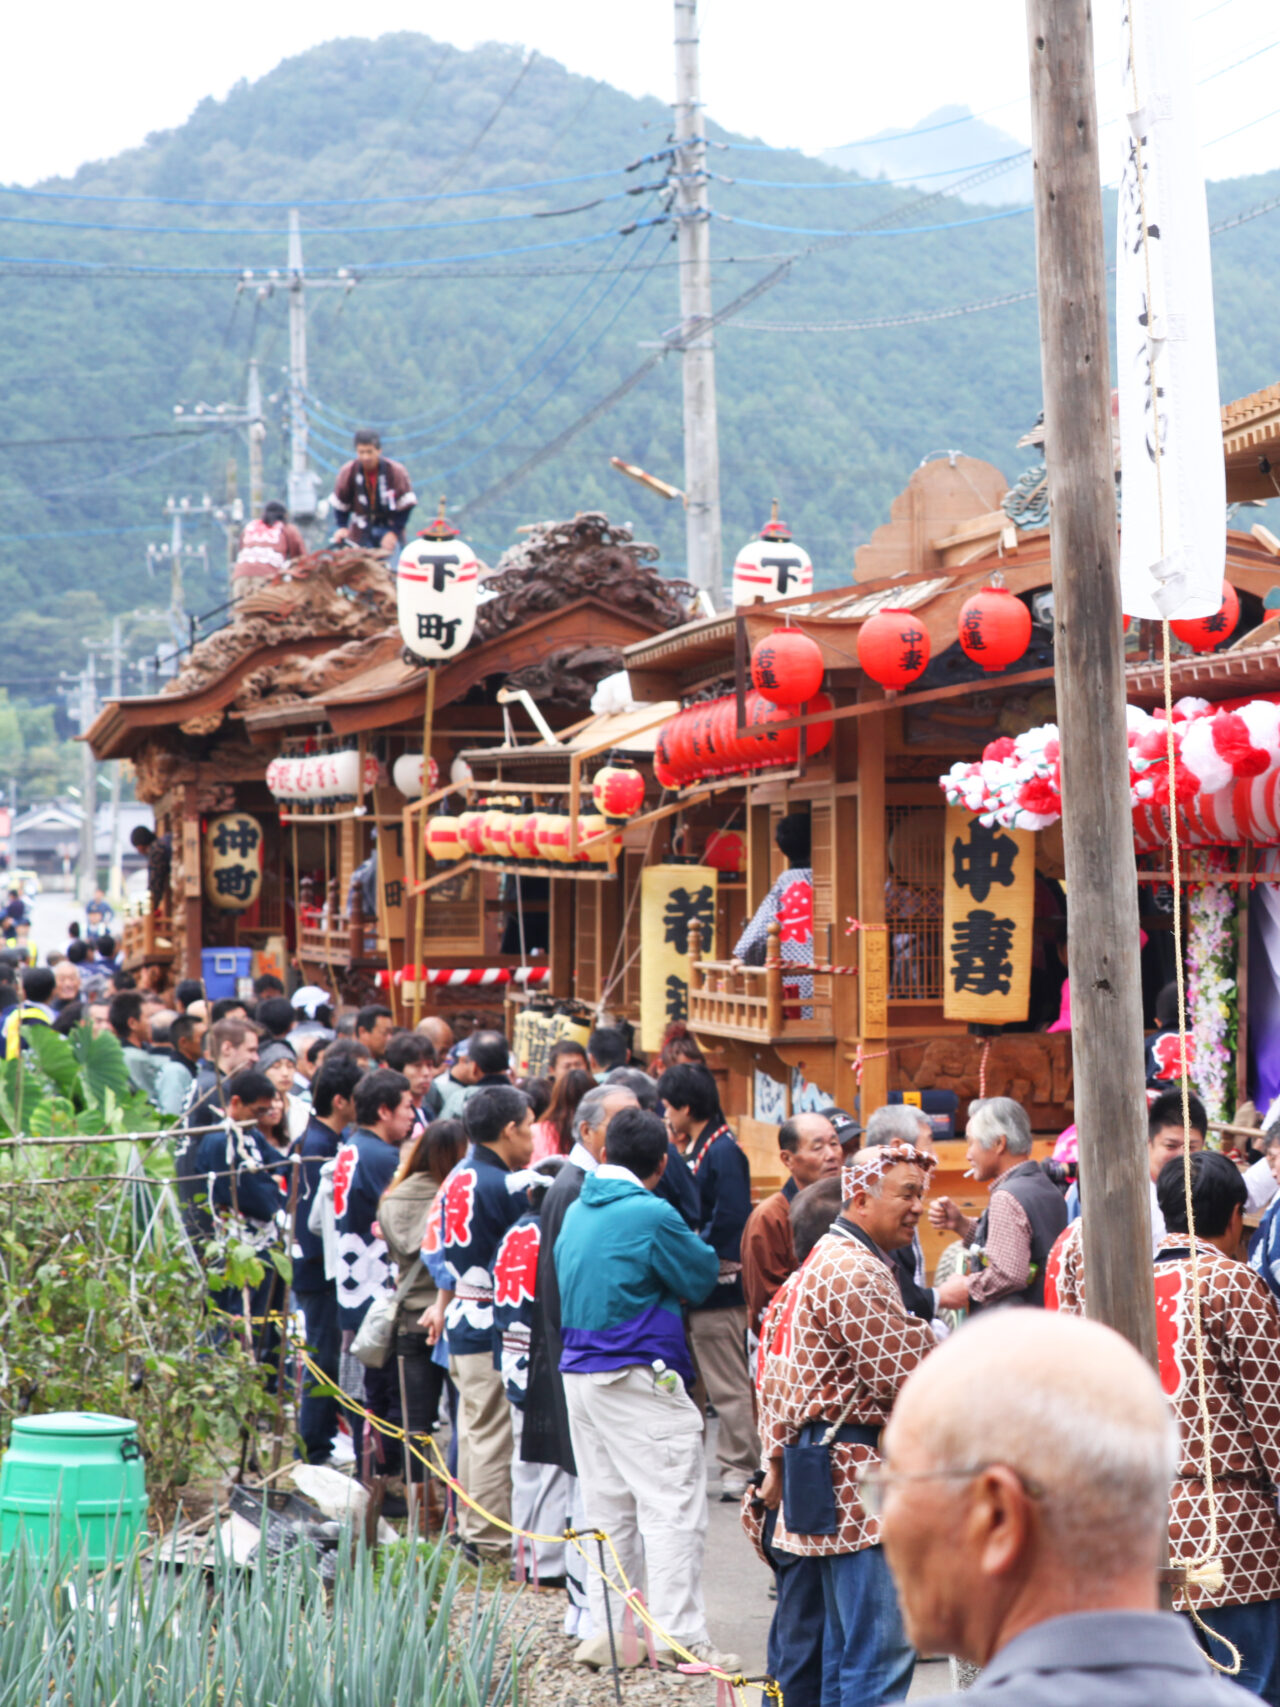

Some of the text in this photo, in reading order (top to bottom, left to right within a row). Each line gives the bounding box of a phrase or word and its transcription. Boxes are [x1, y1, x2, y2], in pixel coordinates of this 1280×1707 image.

[417, 554, 461, 650] 下町
[962, 609, 987, 651] 若連
[755, 648, 780, 689] 若連
[899, 628, 924, 672] 中妻
[213, 820, 260, 900] 仲町
[950, 816, 1020, 997] 中妻
